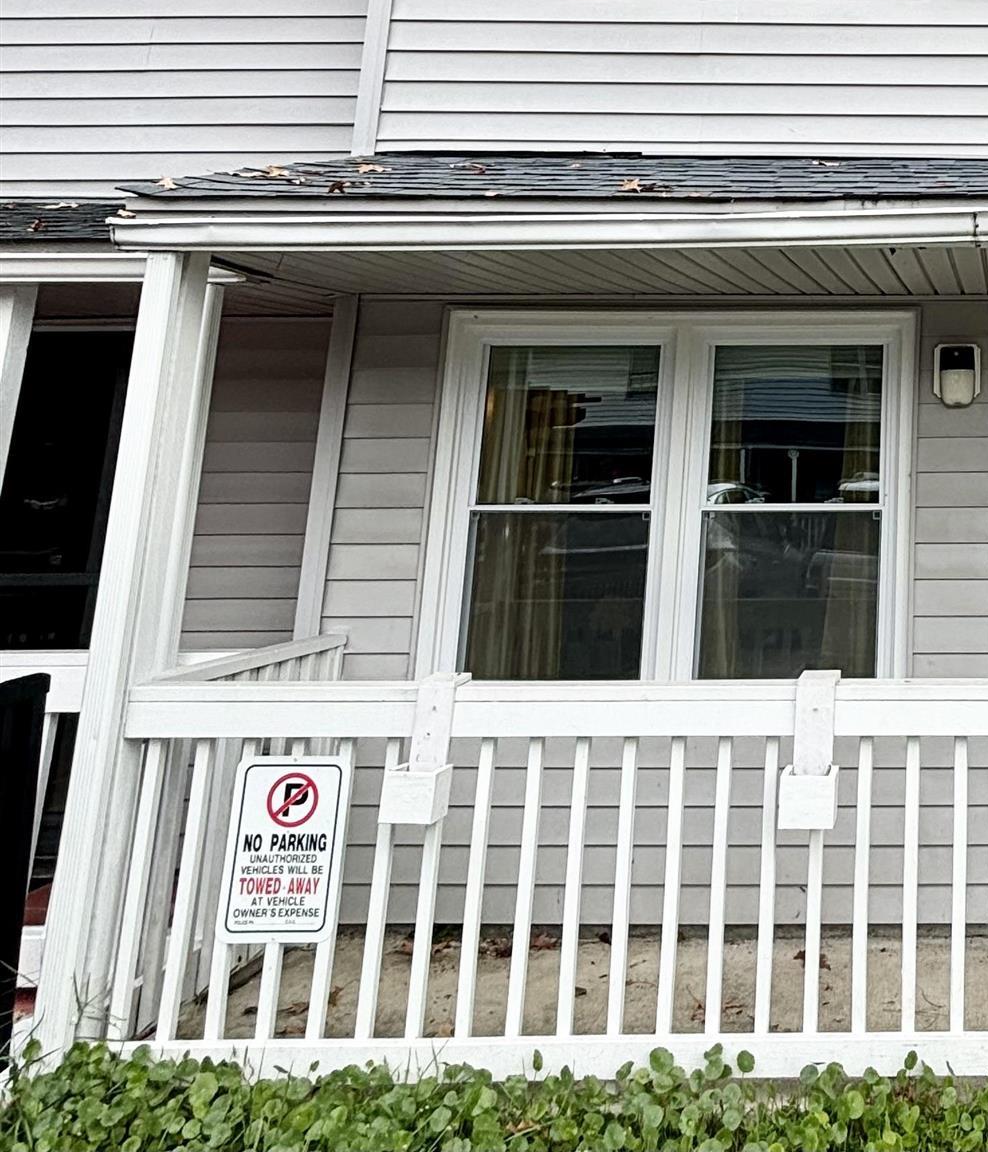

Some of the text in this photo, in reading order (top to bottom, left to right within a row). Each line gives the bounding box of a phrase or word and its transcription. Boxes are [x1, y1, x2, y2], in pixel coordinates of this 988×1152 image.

[242, 833, 327, 853] NO PARKING
[249, 854, 318, 864] UNAUTHORIZED
[241, 865, 324, 875] VEHICLES WILL BE
[239, 877, 320, 895] TOWED AWAY
[251, 896, 306, 906] AT VEHICLE
[233, 908, 320, 918] OWNER'S EXPENSE
